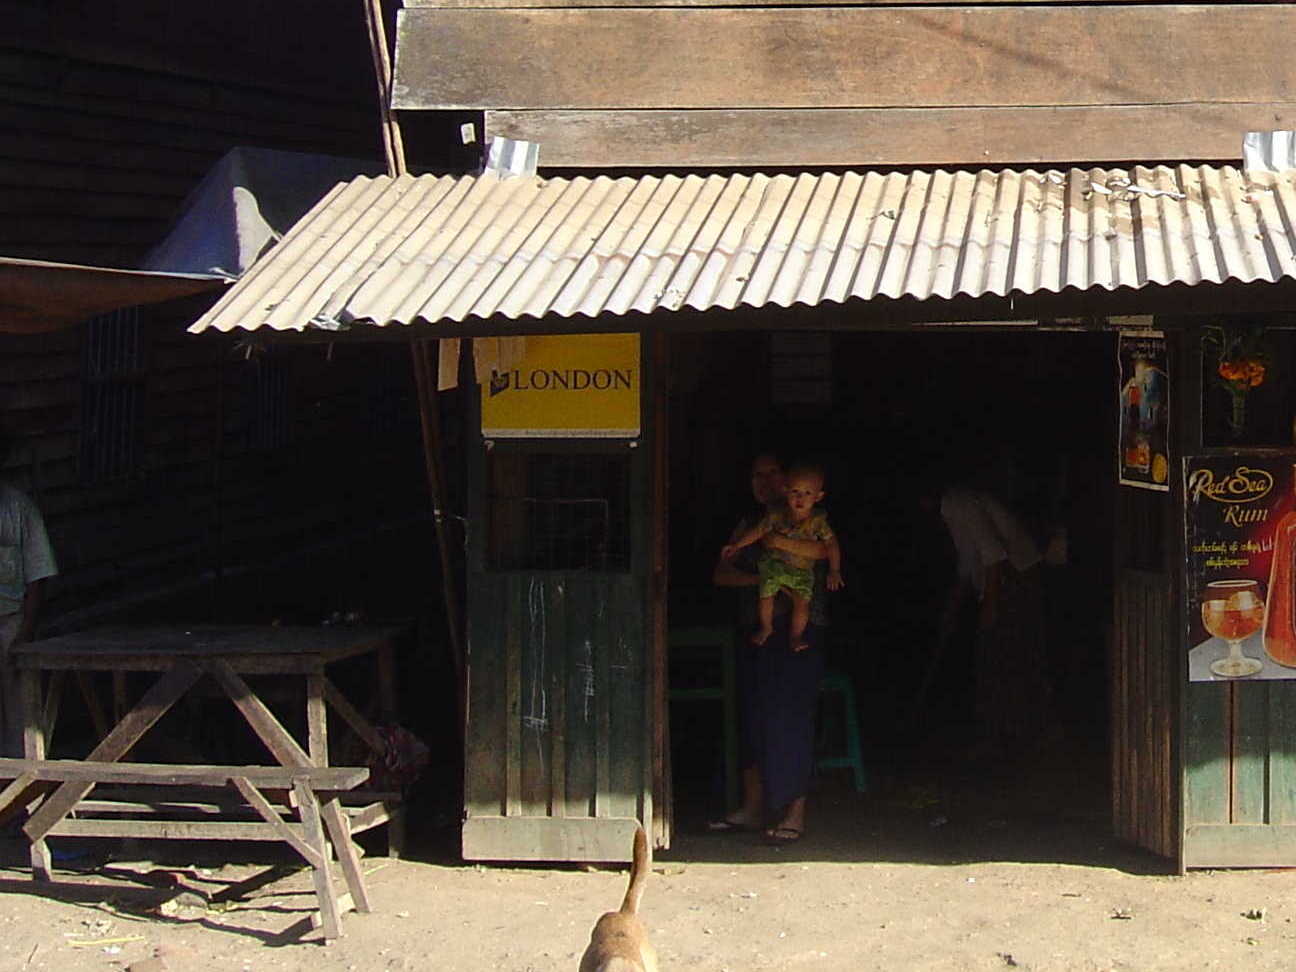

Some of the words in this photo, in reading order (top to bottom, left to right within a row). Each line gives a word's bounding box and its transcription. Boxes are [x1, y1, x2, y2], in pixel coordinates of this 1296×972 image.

[513, 369, 632, 391] LONDON
[1189, 468, 1227, 495] Red
[1228, 466, 1269, 494] Sea
[1222, 504, 1268, 528] Rum
